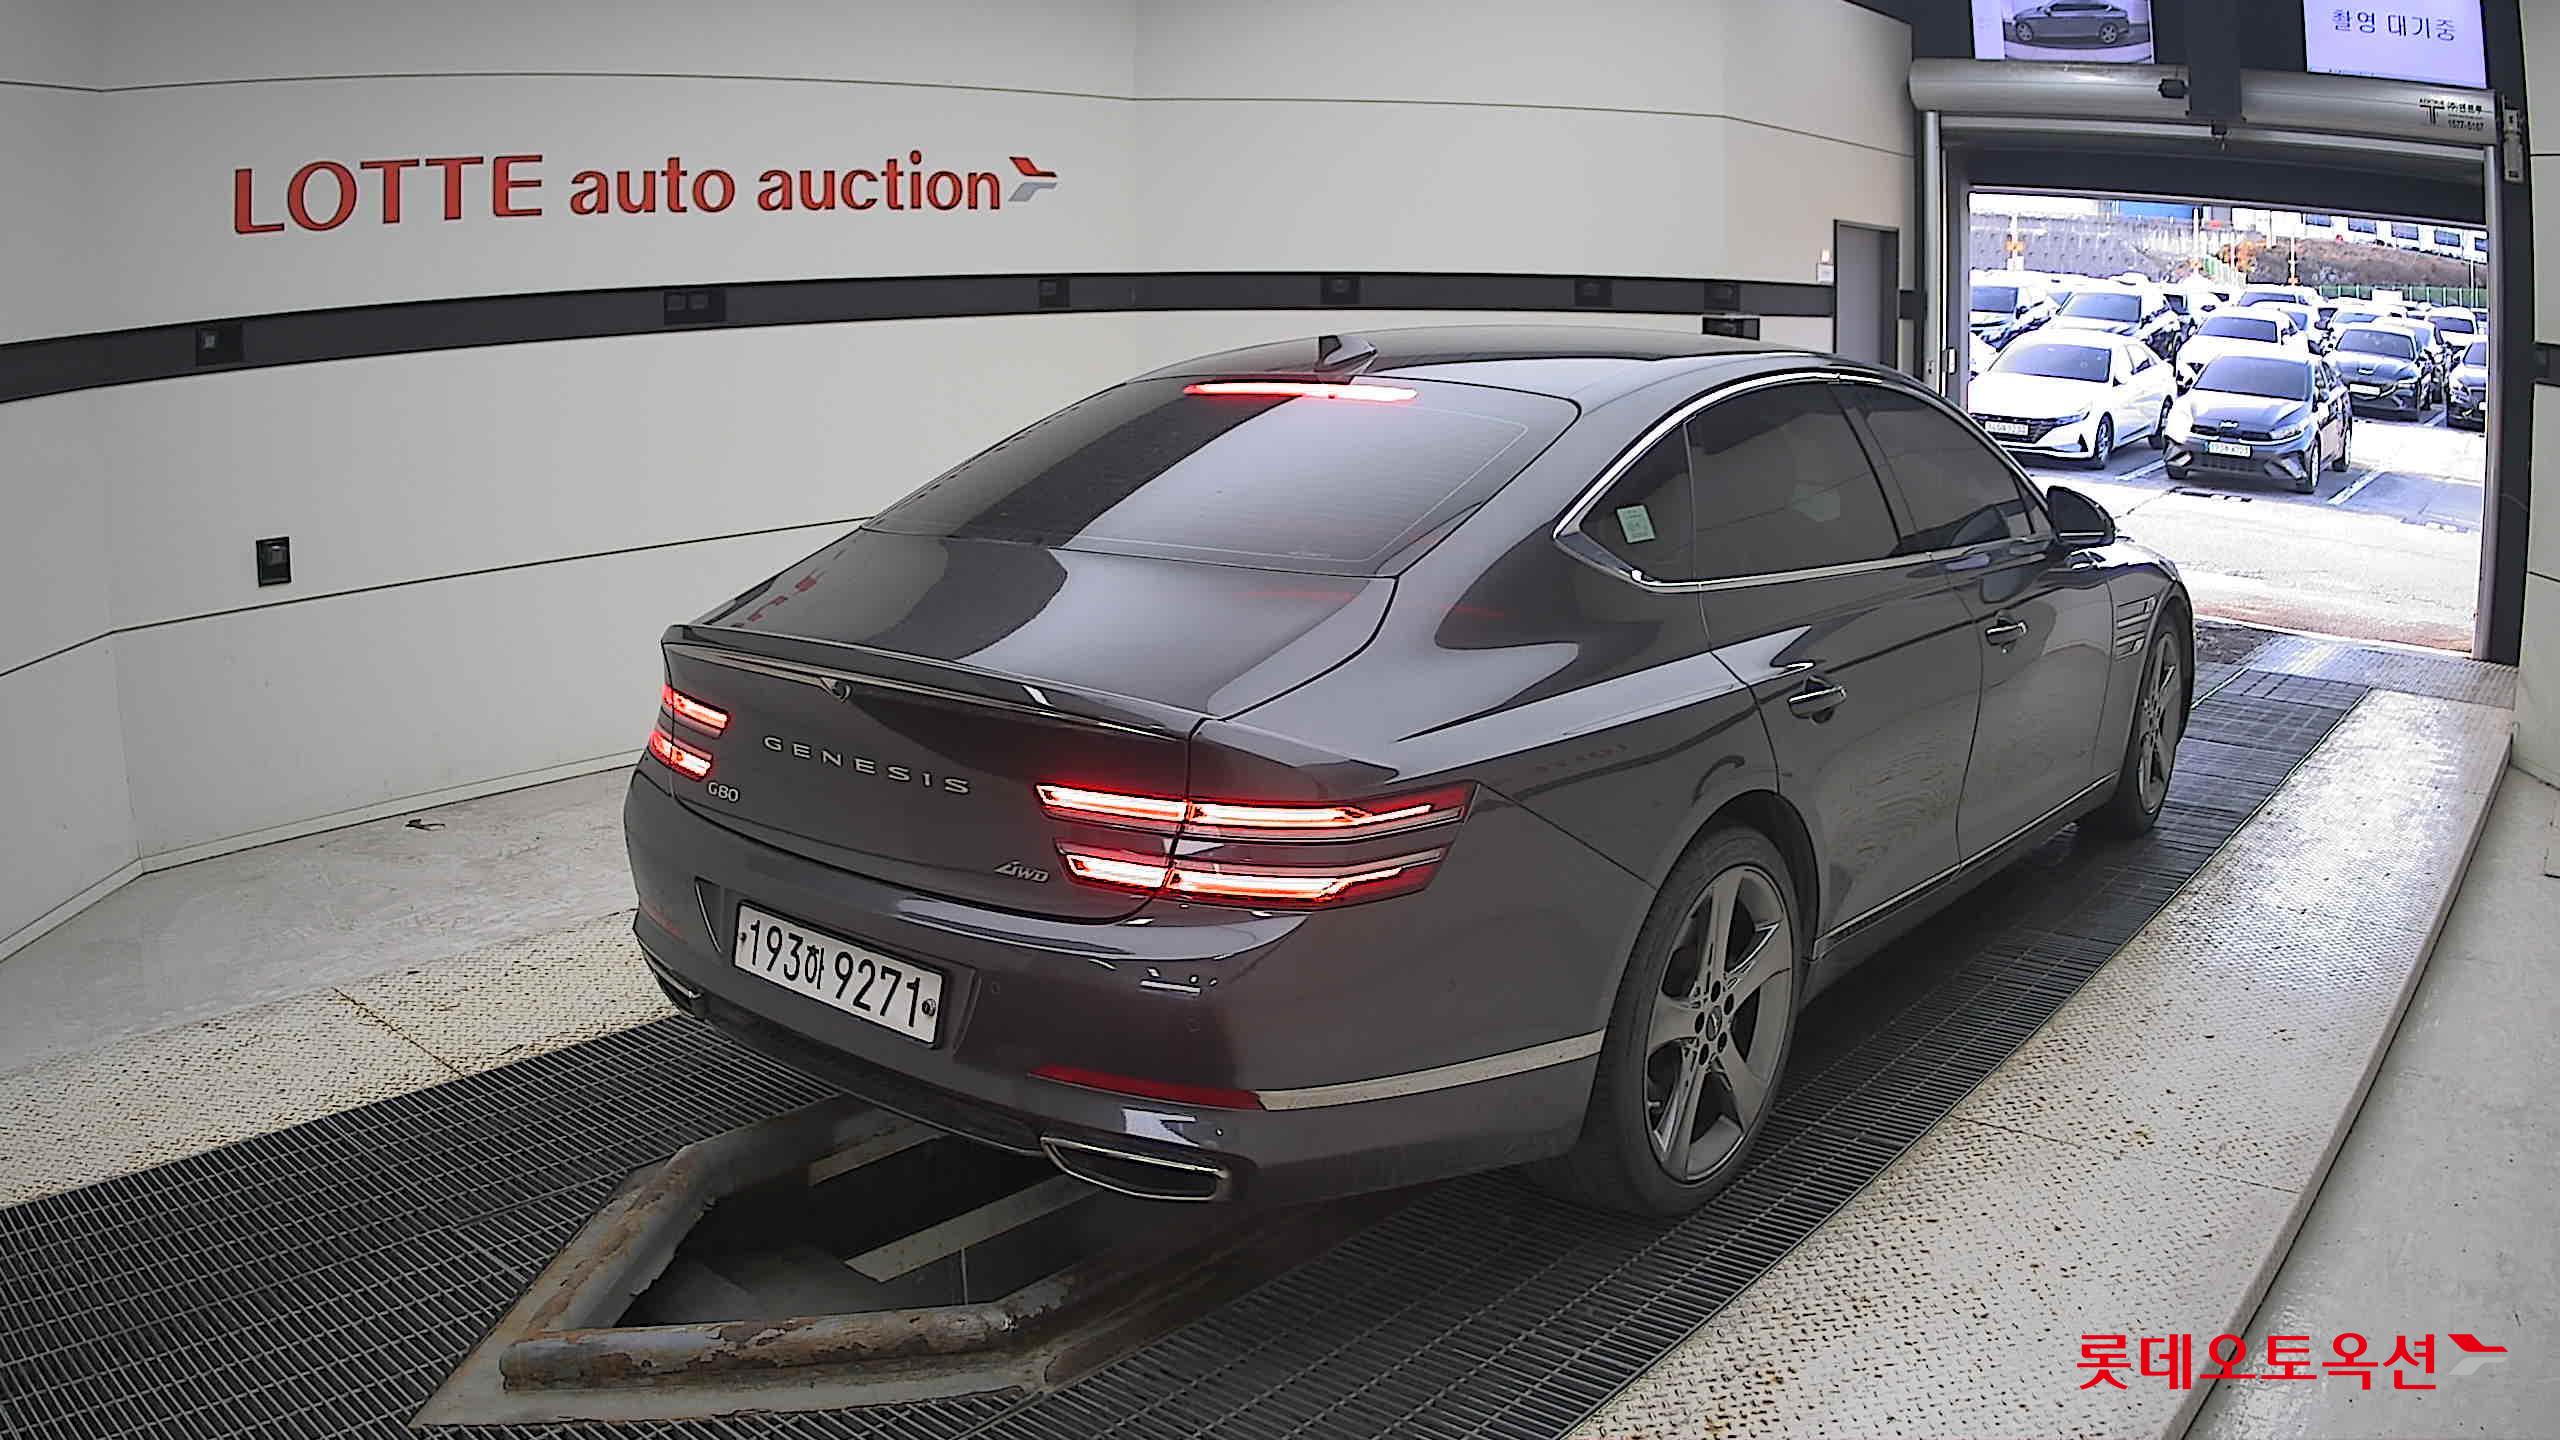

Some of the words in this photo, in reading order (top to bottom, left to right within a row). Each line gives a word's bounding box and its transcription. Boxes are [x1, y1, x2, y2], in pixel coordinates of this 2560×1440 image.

[2387, 14, 2456, 42] 대기중
[234, 153, 543, 235] LOTTE
[569, 155, 737, 216] auto
[757, 149, 1002, 213] auction
[708, 782, 739, 802] G80
[764, 736, 969, 794] GENESIS
[750, 919, 825, 990] 193하
[834, 951, 920, 1028] 9271
